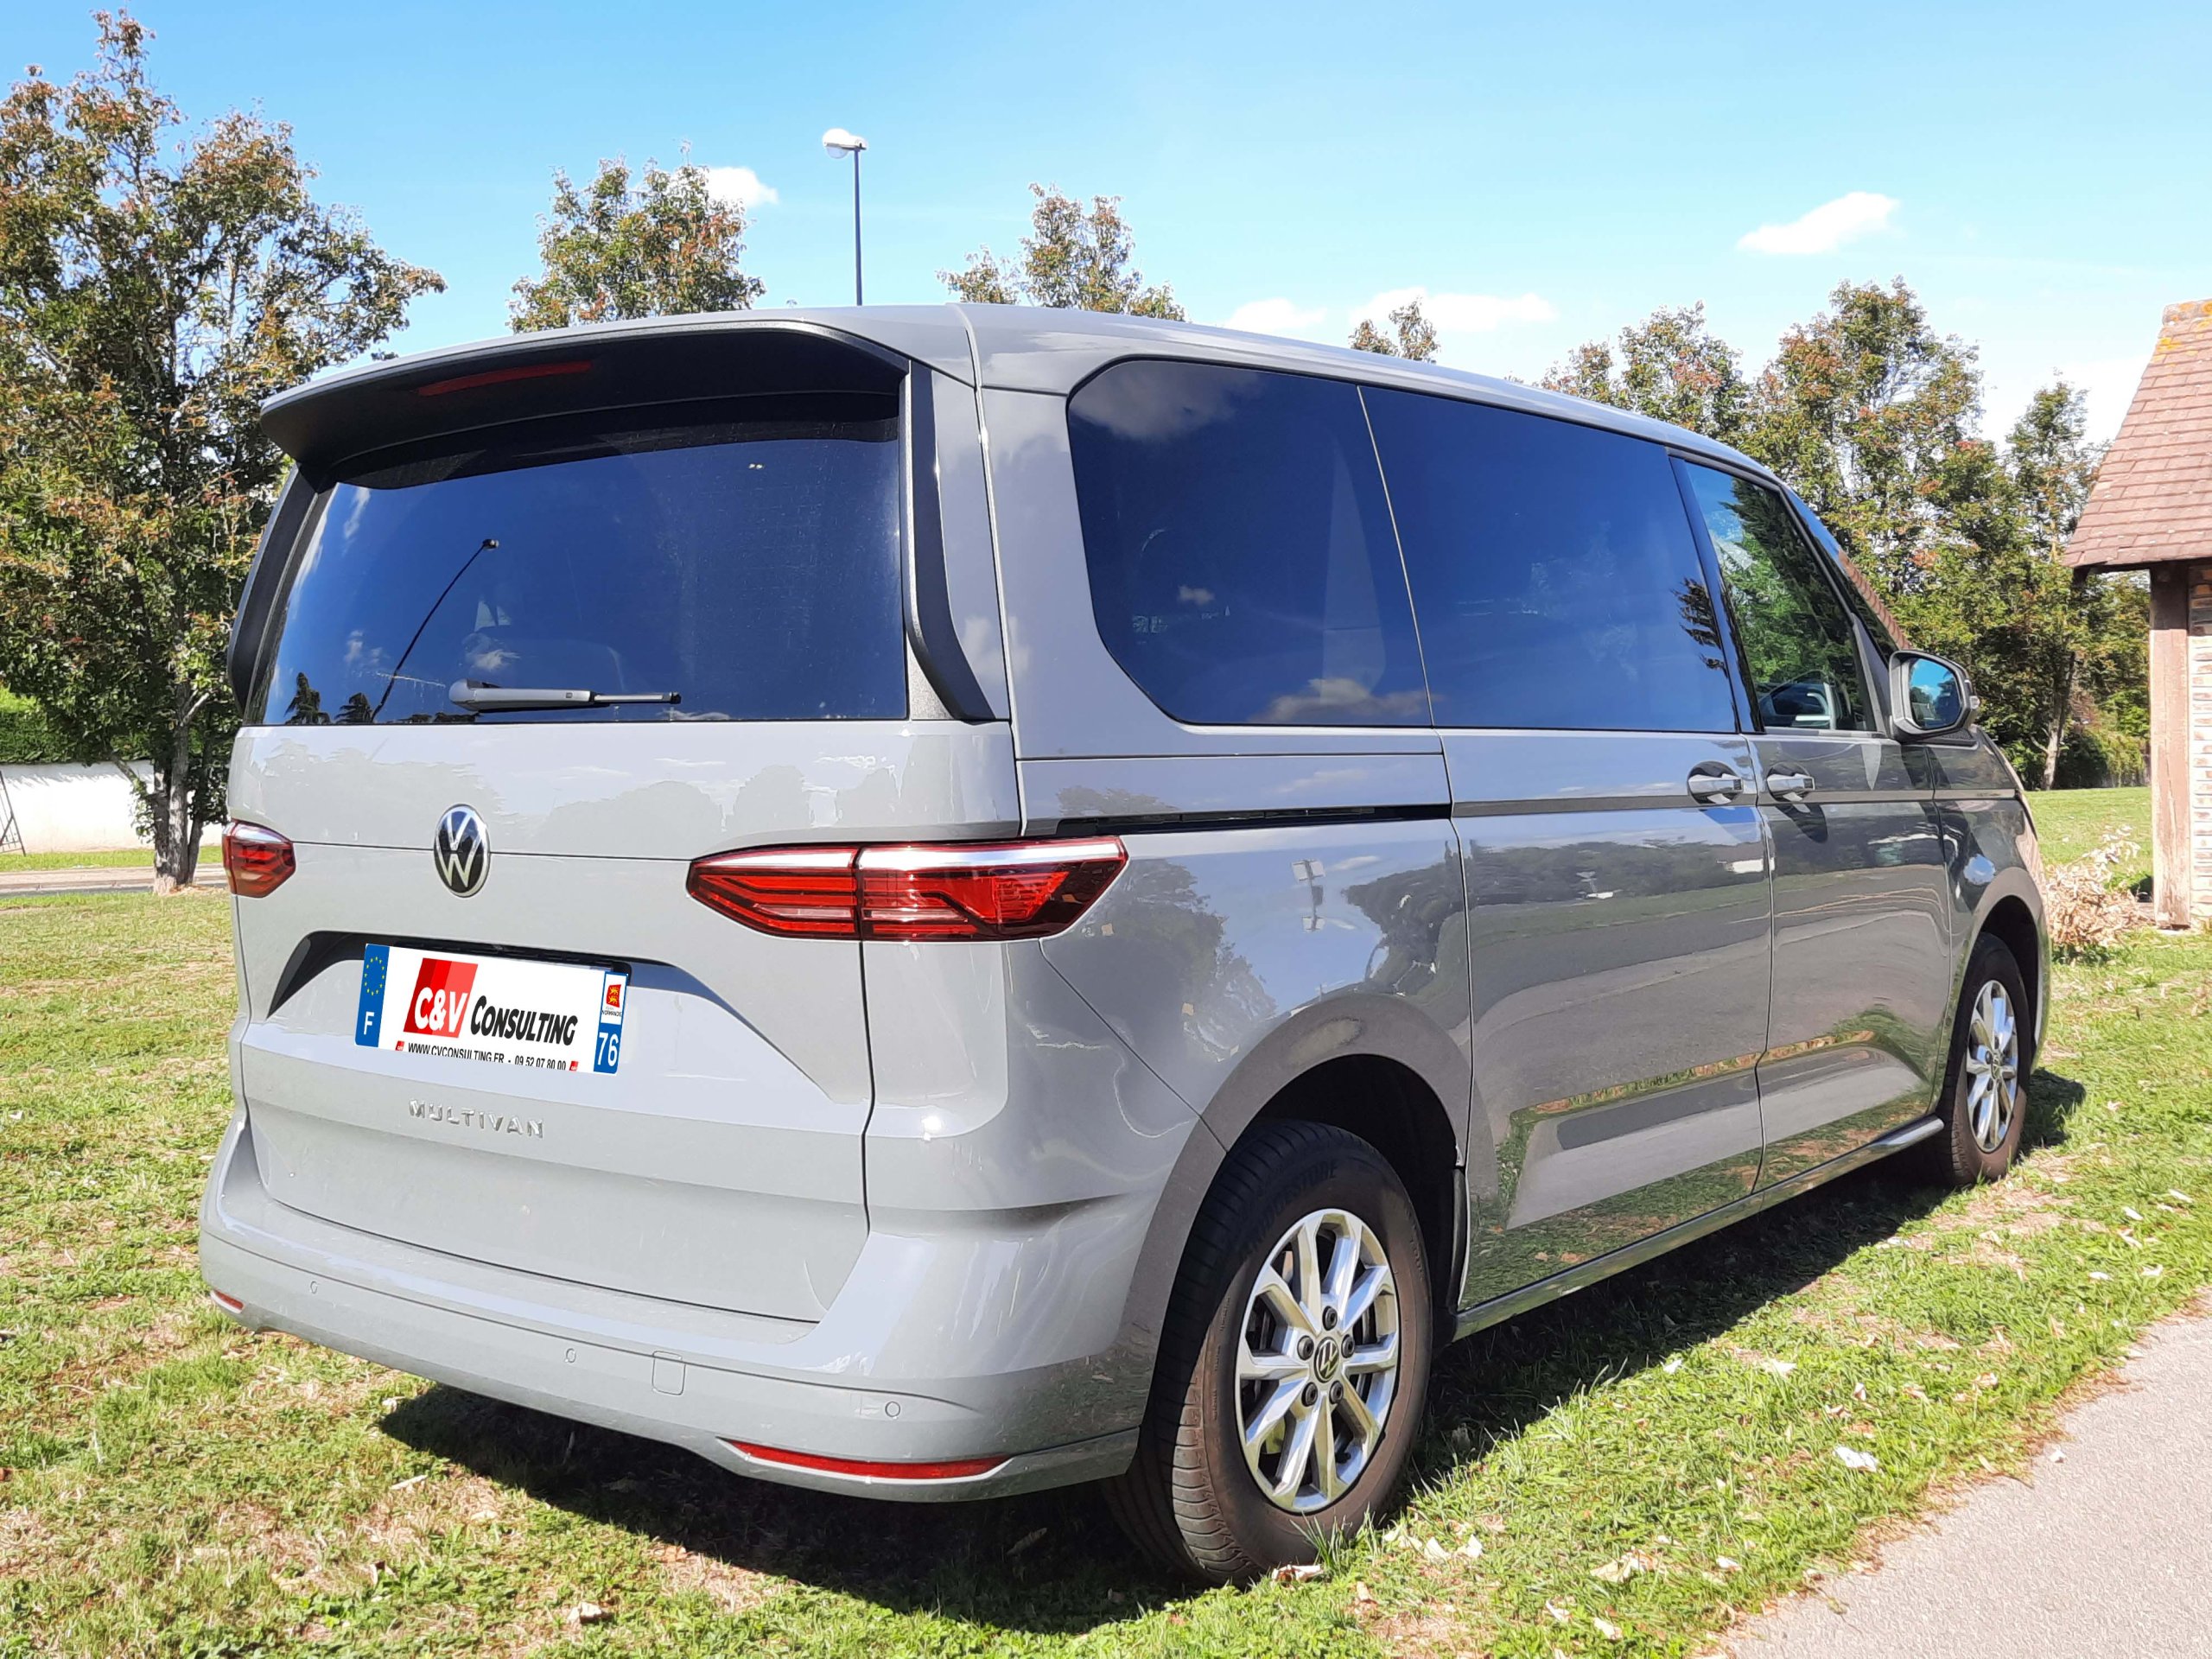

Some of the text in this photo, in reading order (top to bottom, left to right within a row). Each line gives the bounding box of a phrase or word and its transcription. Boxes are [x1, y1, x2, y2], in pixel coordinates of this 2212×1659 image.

[364, 1011, 375, 1035] F
[414, 987, 578, 1046] C&V CONSULTING
[597, 1032, 619, 1066] 76
[409, 1098, 543, 1138] MULTIVAN
